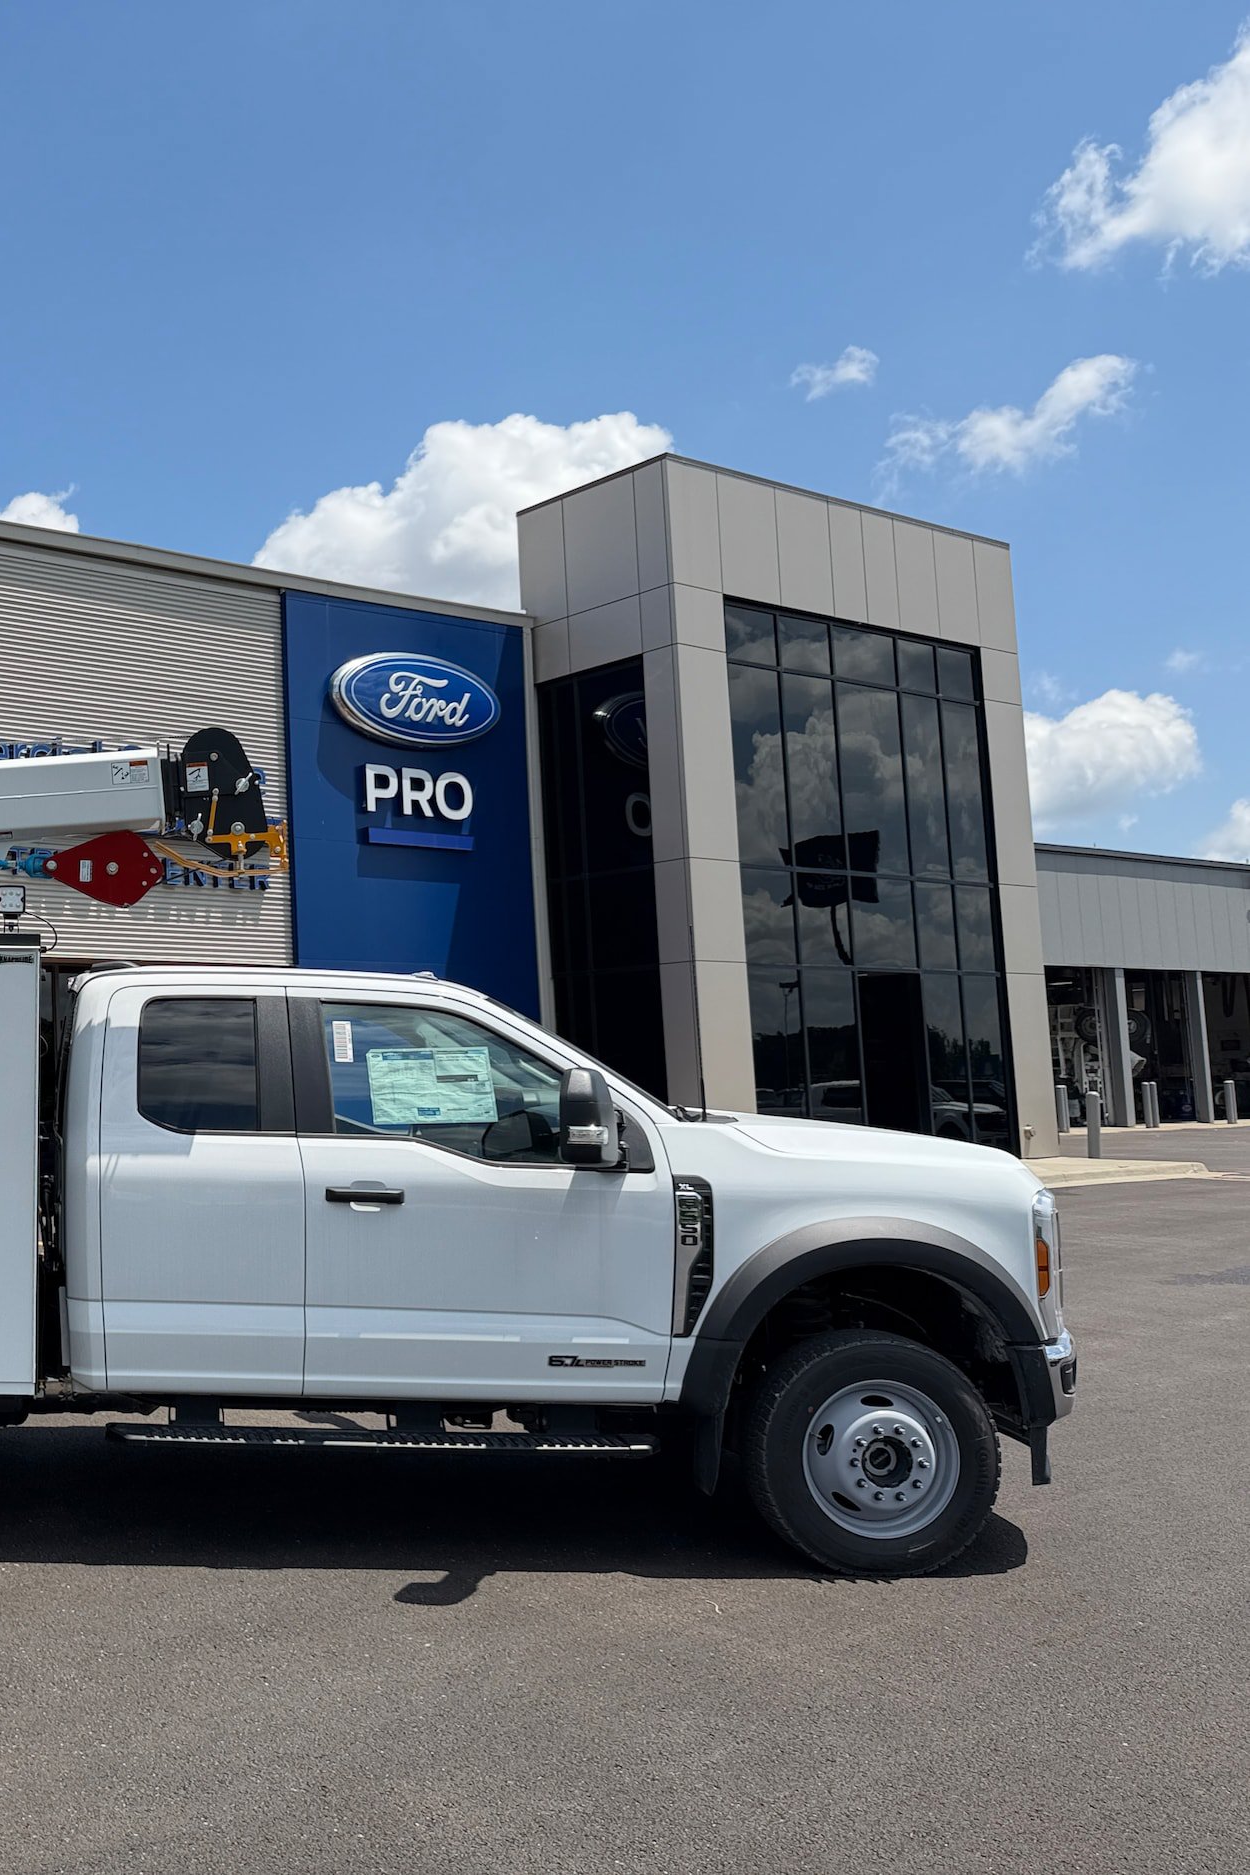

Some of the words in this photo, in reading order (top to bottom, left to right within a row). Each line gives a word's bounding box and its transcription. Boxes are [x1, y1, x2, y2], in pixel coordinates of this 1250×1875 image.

[380, 671, 471, 727] Ford
[365, 763, 473, 821] PRO
[547, 1355, 584, 1367] 6.7L
